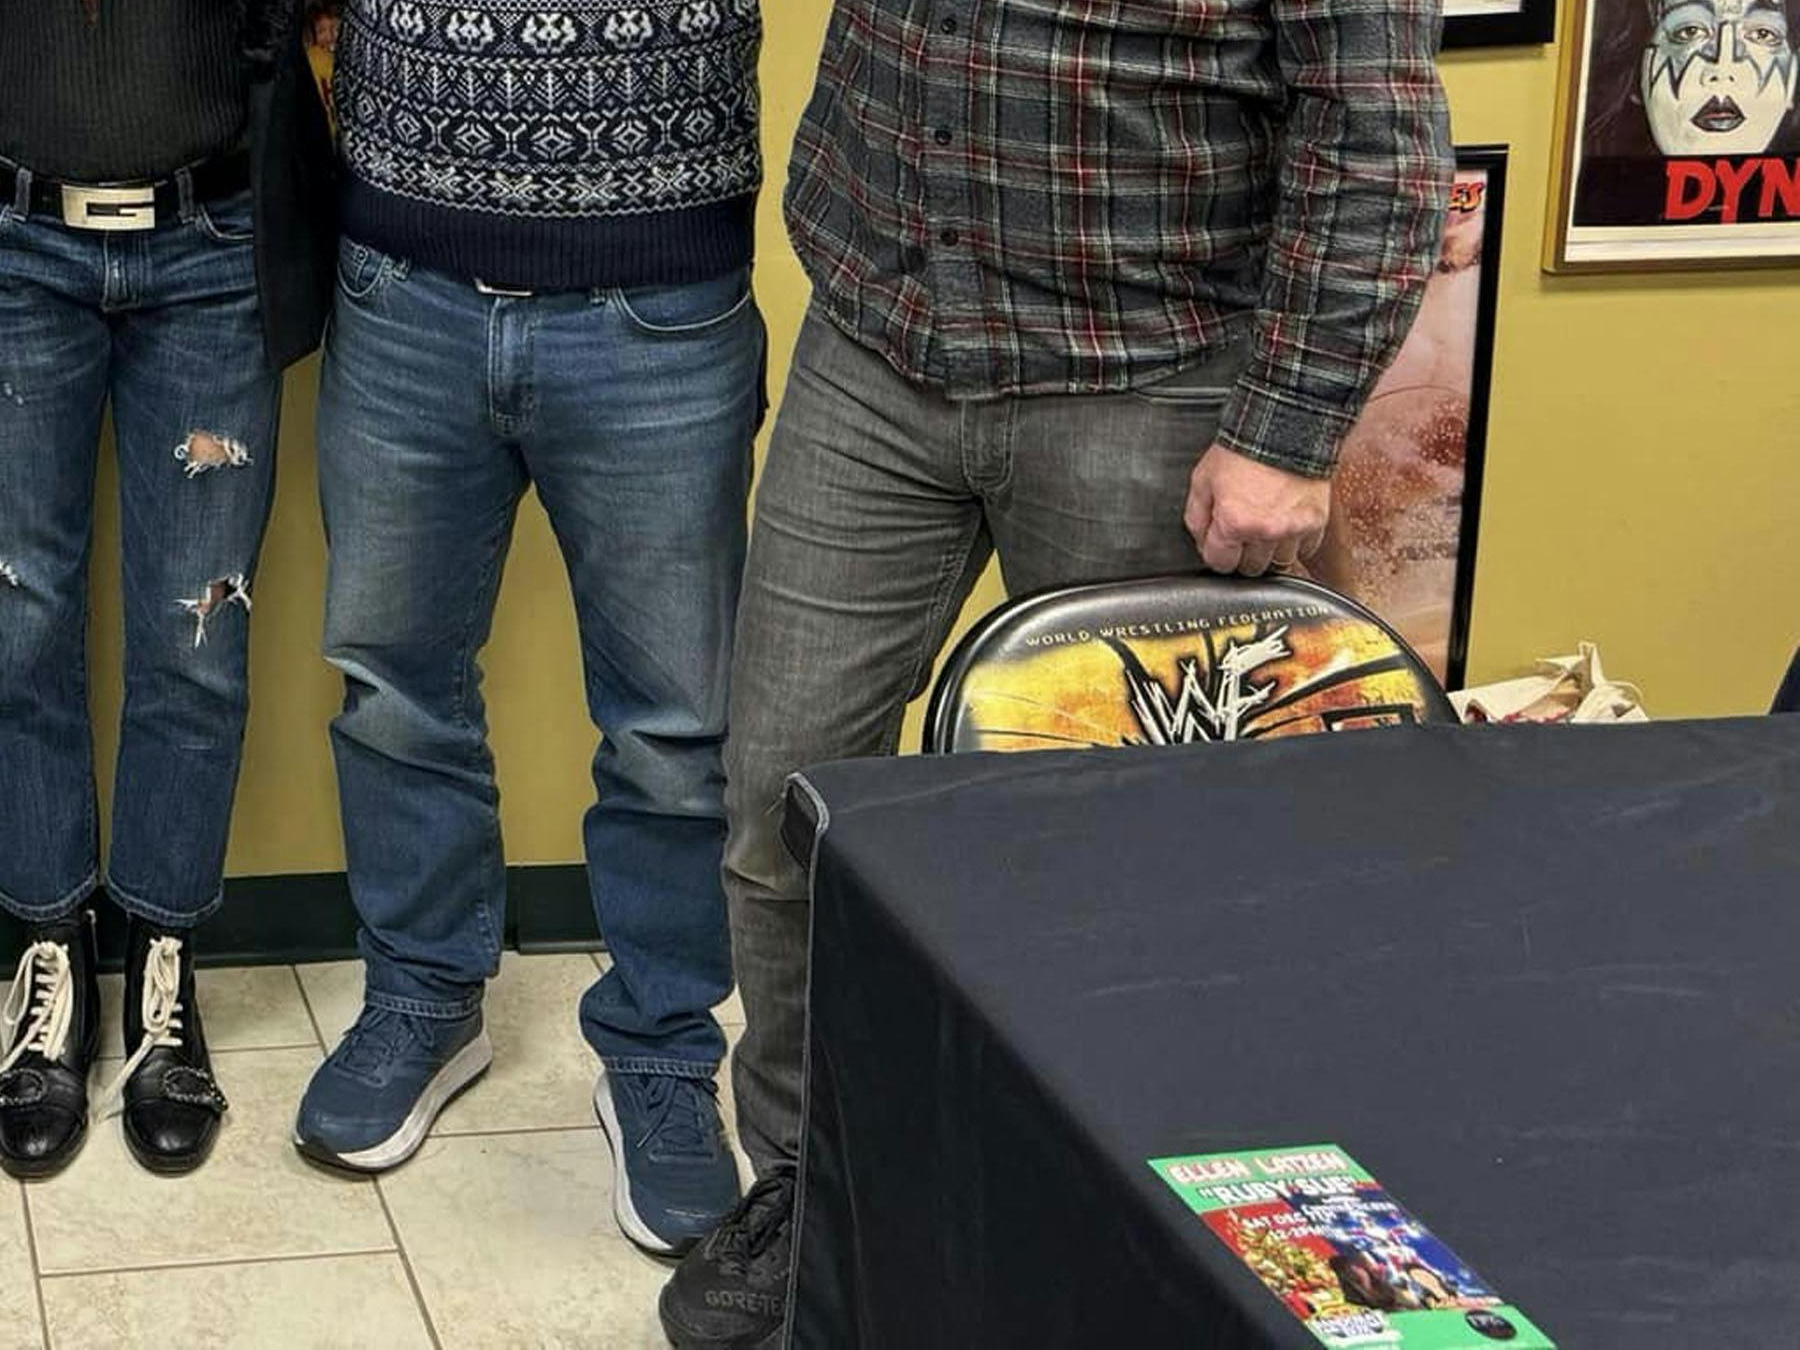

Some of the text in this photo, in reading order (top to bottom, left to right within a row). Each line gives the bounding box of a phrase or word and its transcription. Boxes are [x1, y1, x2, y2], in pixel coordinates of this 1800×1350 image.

[1026, 604, 1330, 648] WORLD WRESTLING FEDERATION
[1167, 1157, 1250, 1184] ELLEN
